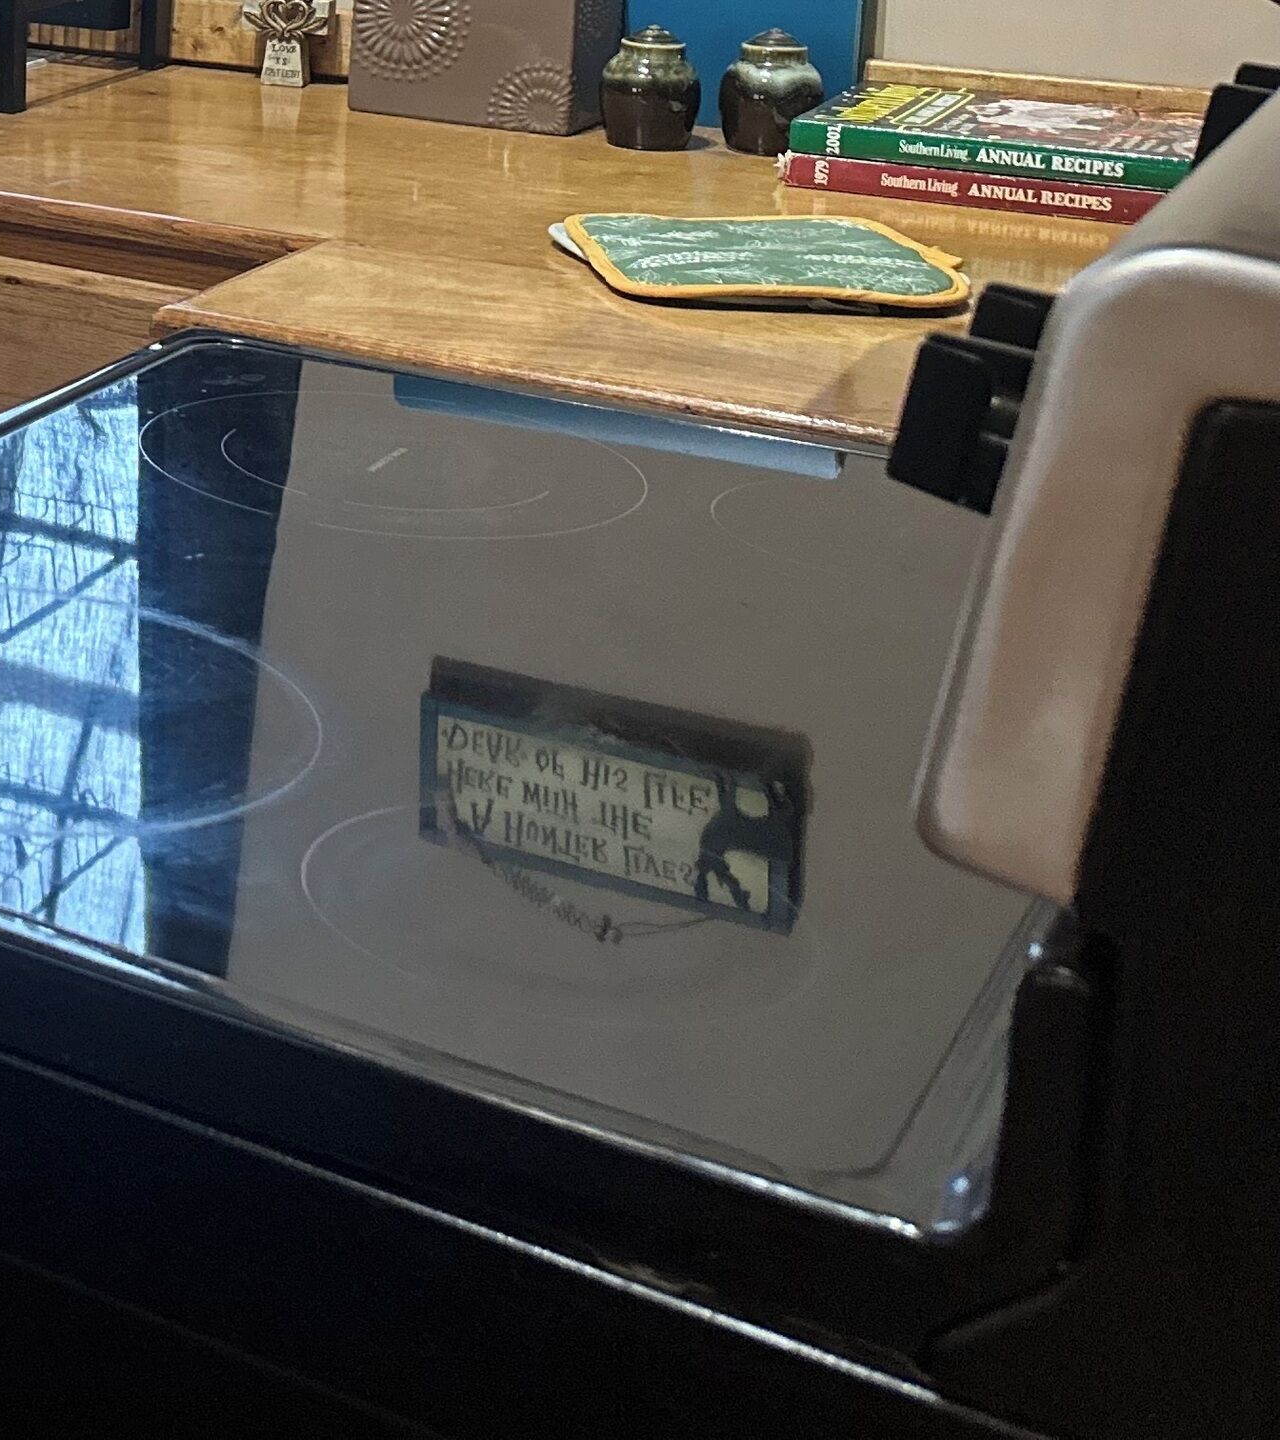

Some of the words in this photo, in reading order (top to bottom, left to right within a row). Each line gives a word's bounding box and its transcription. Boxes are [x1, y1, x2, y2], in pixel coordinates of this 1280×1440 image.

[271, 43, 297, 53] LOVE
[826, 124, 842, 155] 2001
[813, 159, 830, 187] 1979
[898, 139, 940, 159] Southern
[940, 142, 969, 162] Living
[976, 147, 1046, 170] ANNUAL
[1051, 155, 1125, 178] RECIPES
[880, 173, 926, 192] Southern
[927, 177, 959, 198] Living
[967, 183, 1037, 204] ANNUAL
[1040, 190, 1113, 213] RECIPES
